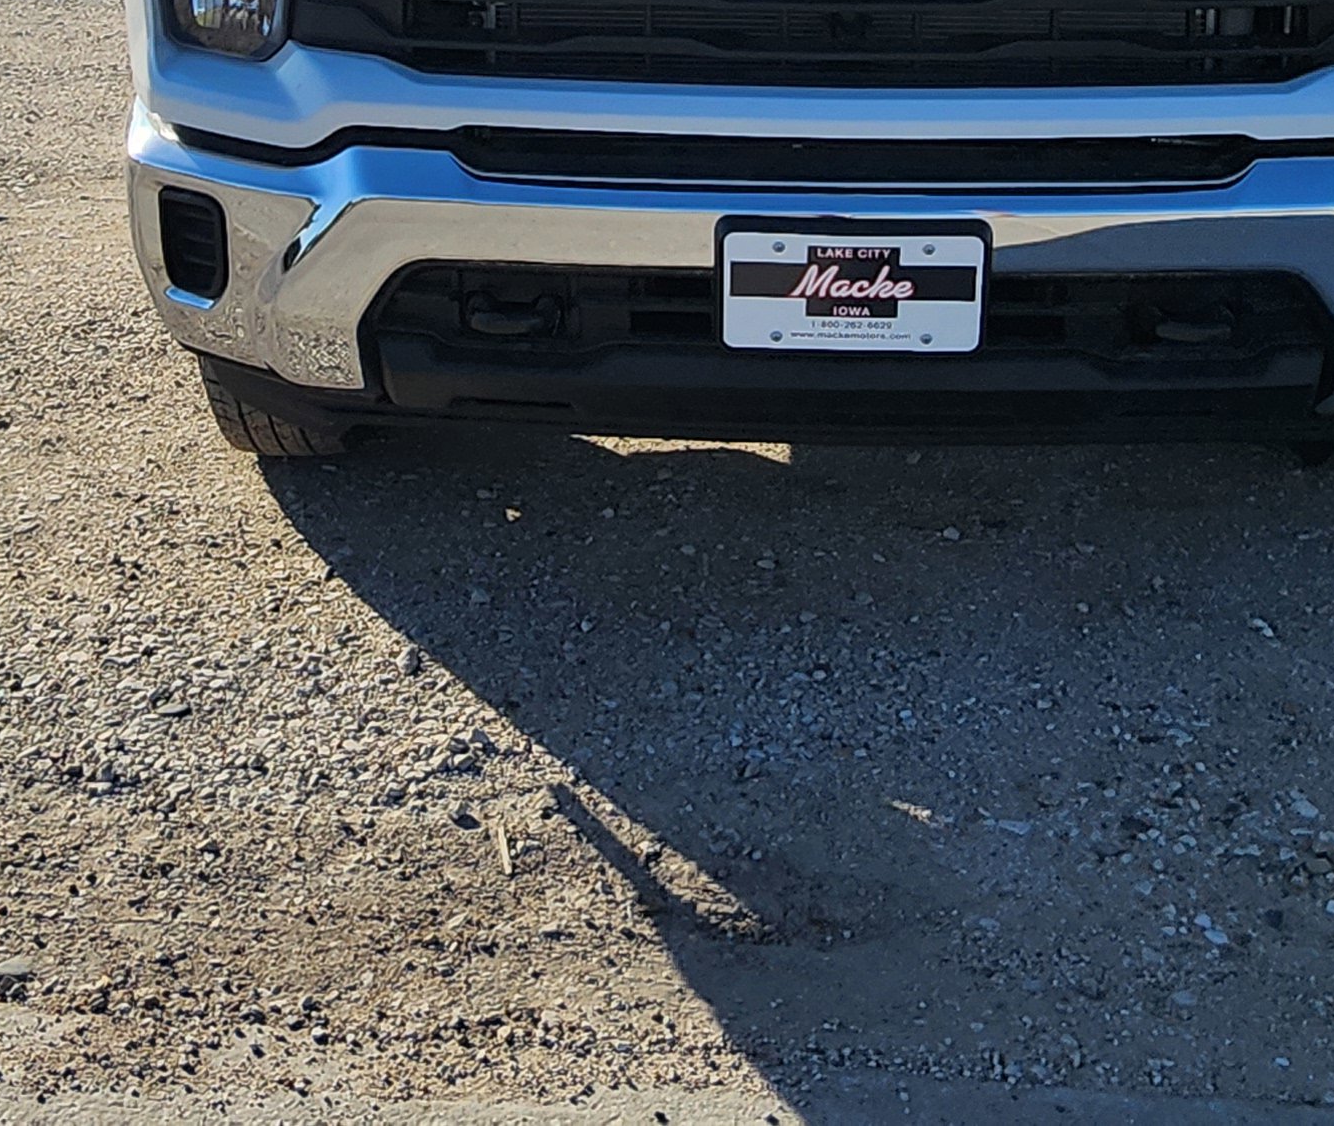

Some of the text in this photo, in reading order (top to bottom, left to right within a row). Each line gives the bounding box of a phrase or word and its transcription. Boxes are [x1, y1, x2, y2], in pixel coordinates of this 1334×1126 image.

[816, 248, 891, 260] LAKE CITY
[789, 264, 914, 299] Macke
[832, 306, 871, 317] IOWA
